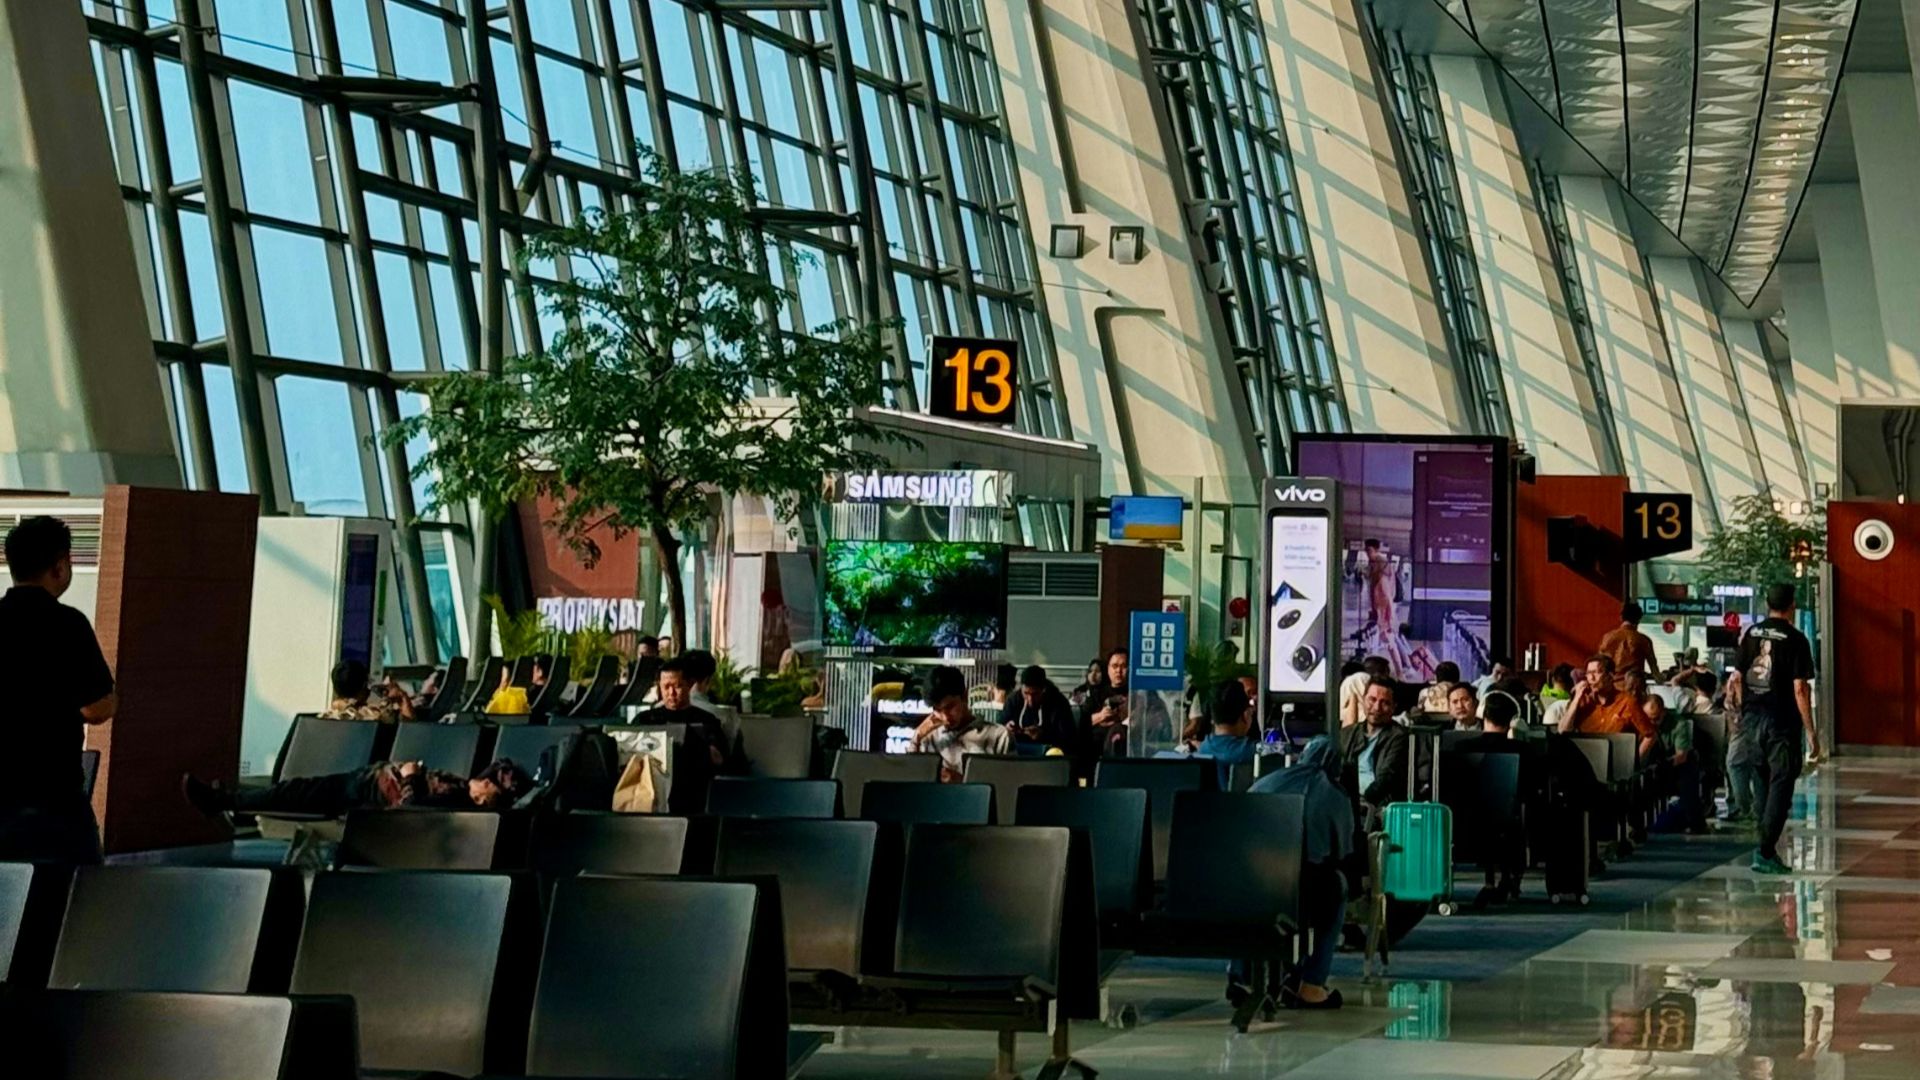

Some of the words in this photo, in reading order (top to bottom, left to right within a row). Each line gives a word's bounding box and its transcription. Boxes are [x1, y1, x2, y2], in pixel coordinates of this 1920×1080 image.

[944, 347, 1012, 414] 13
[848, 474, 972, 499] SAMSUNG
[1274, 484, 1326, 502] vivo
[1634, 502, 1682, 539] 13
[608, 597, 645, 634] SEAT
